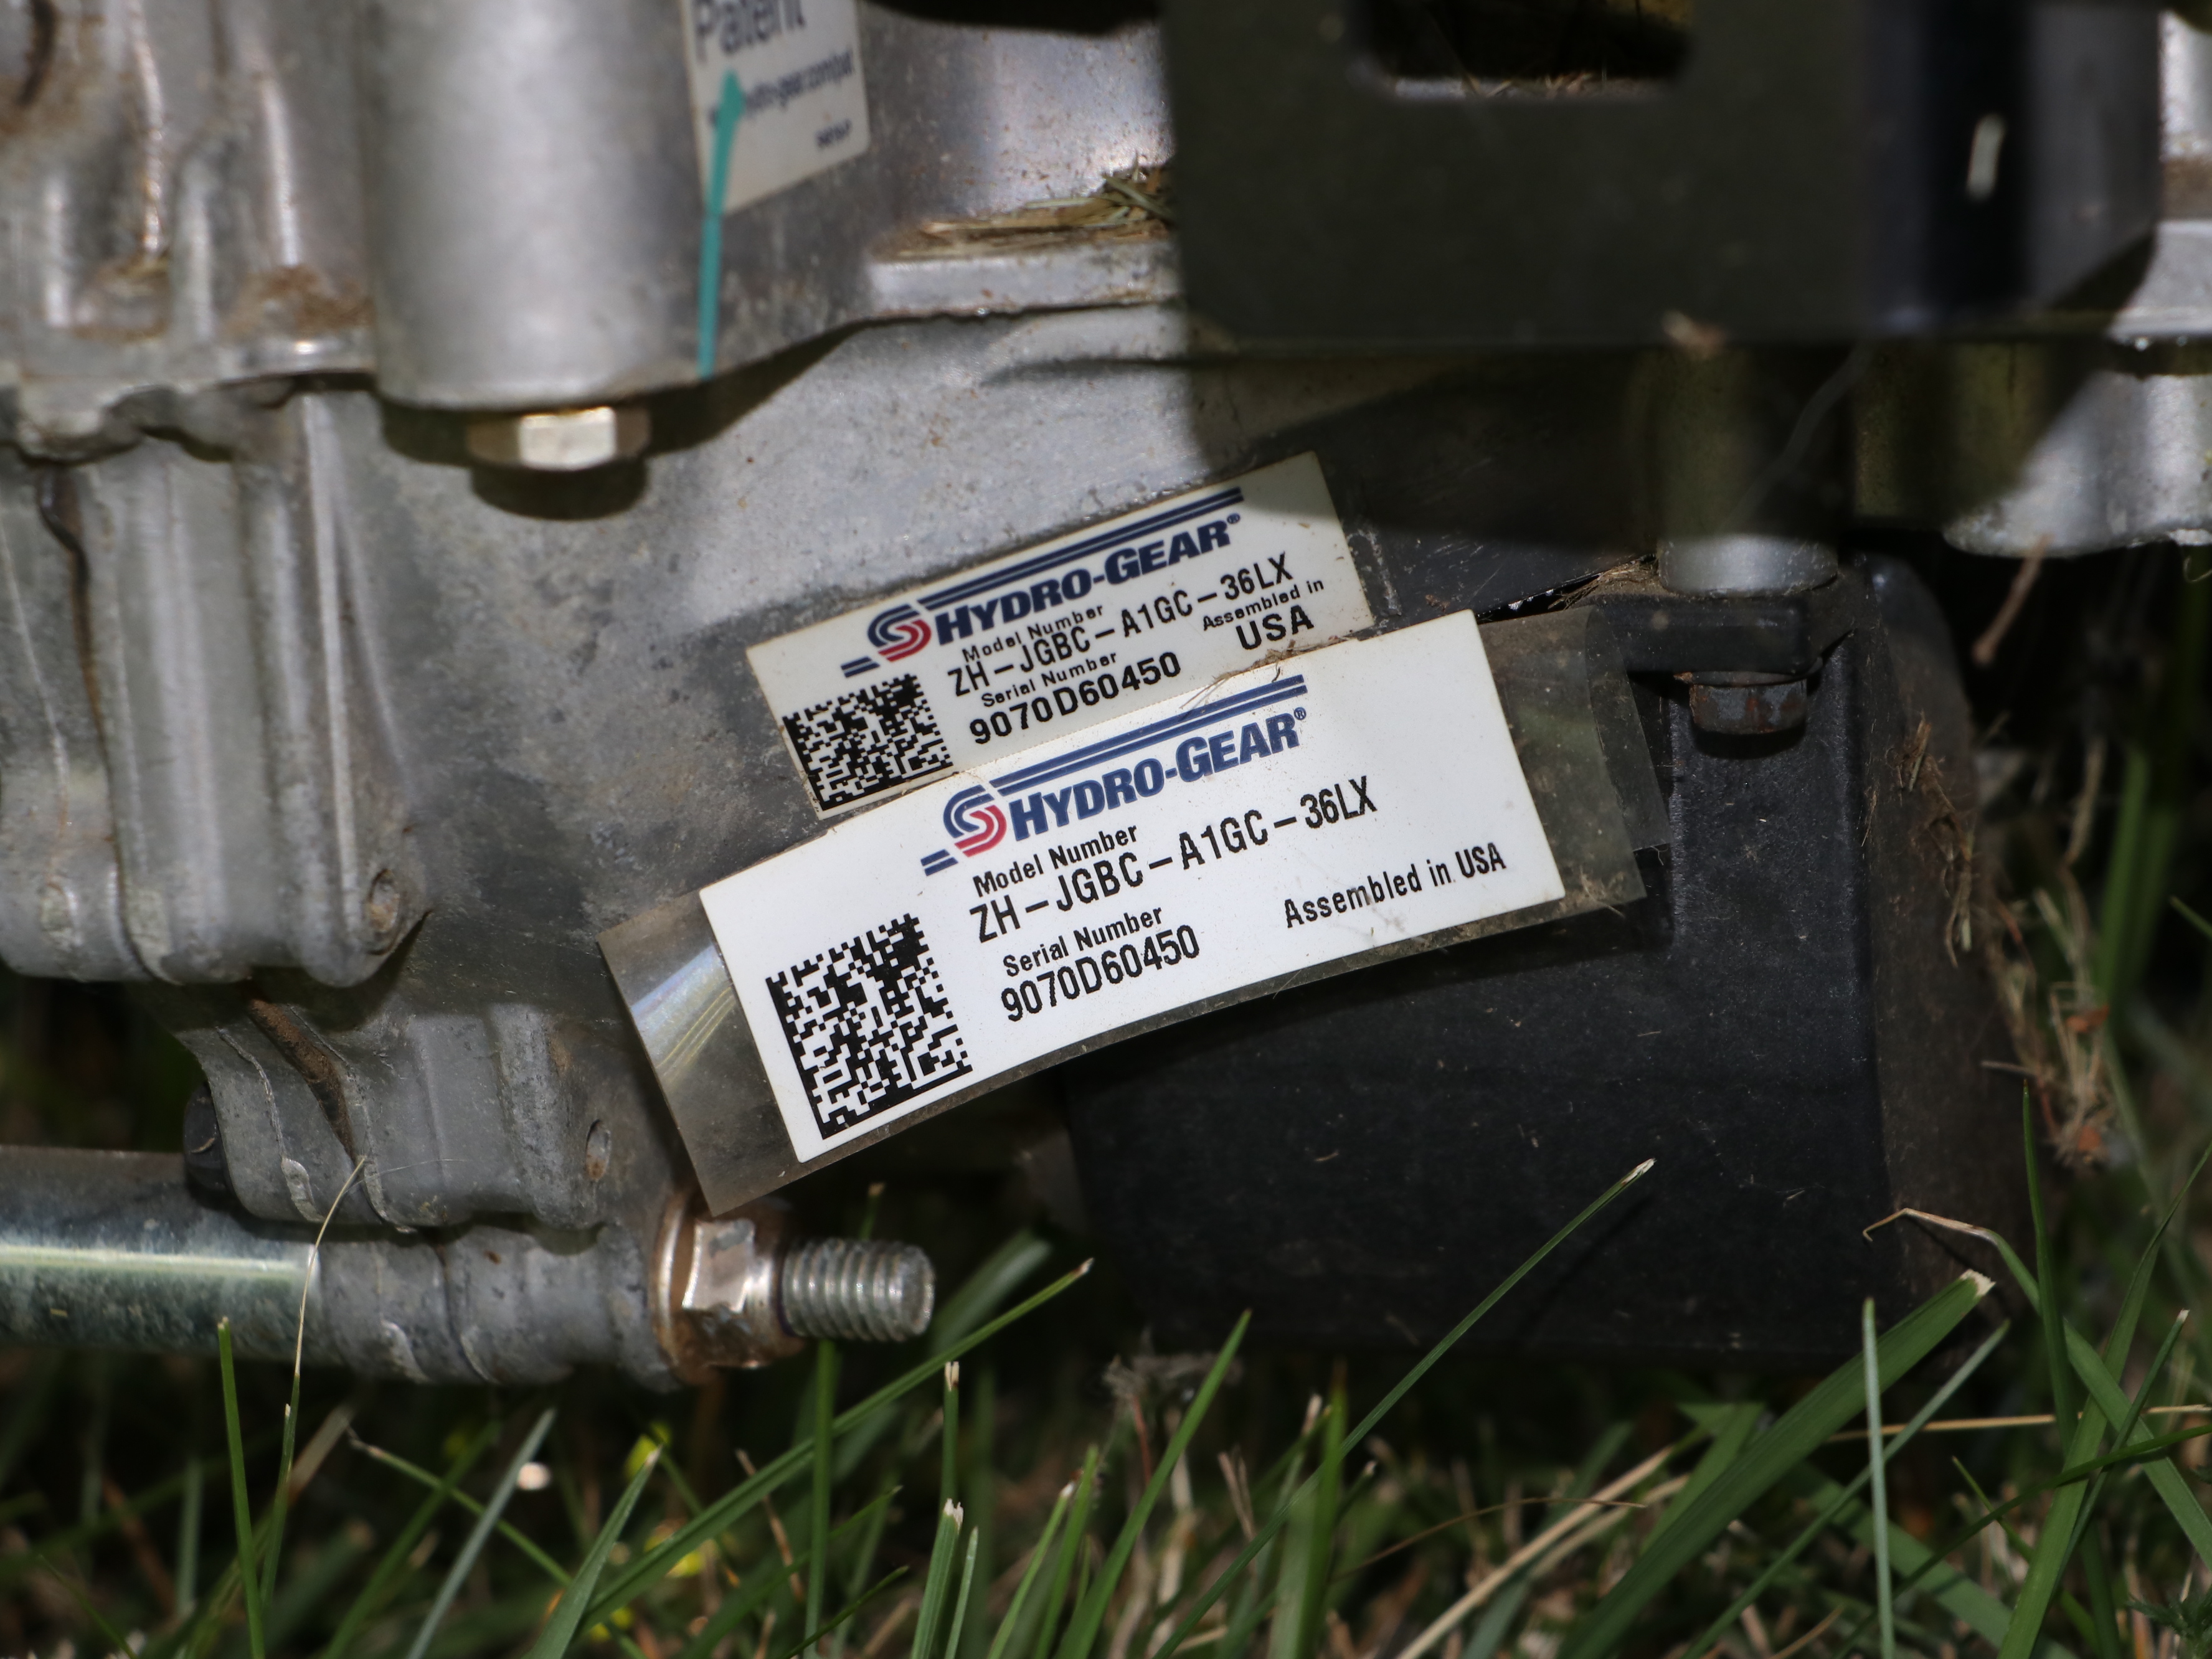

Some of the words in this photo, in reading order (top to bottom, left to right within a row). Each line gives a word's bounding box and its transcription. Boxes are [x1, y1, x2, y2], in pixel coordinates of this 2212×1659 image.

[962, 632, 1023, 663] Model
[1028, 605, 1104, 640] Number
[1203, 584, 1301, 631] Assembled
[1307, 579, 1325, 593] in
[1236, 605, 1315, 650] USA
[970, 651, 1181, 745] 9070D60450
[981, 681, 1036, 707] Serial
[1041, 652, 1117, 687] Number
[973, 854, 1044, 897] Model
[1049, 825, 1138, 869] Number
[1283, 863, 1422, 929] Assembled
[1426, 859, 1452, 888] in
[1455, 842, 1507, 879] USA
[1001, 925, 1201, 1023] 9070D60450
[1003, 935, 1070, 977] Serial
[1073, 907, 1163, 952] Number
